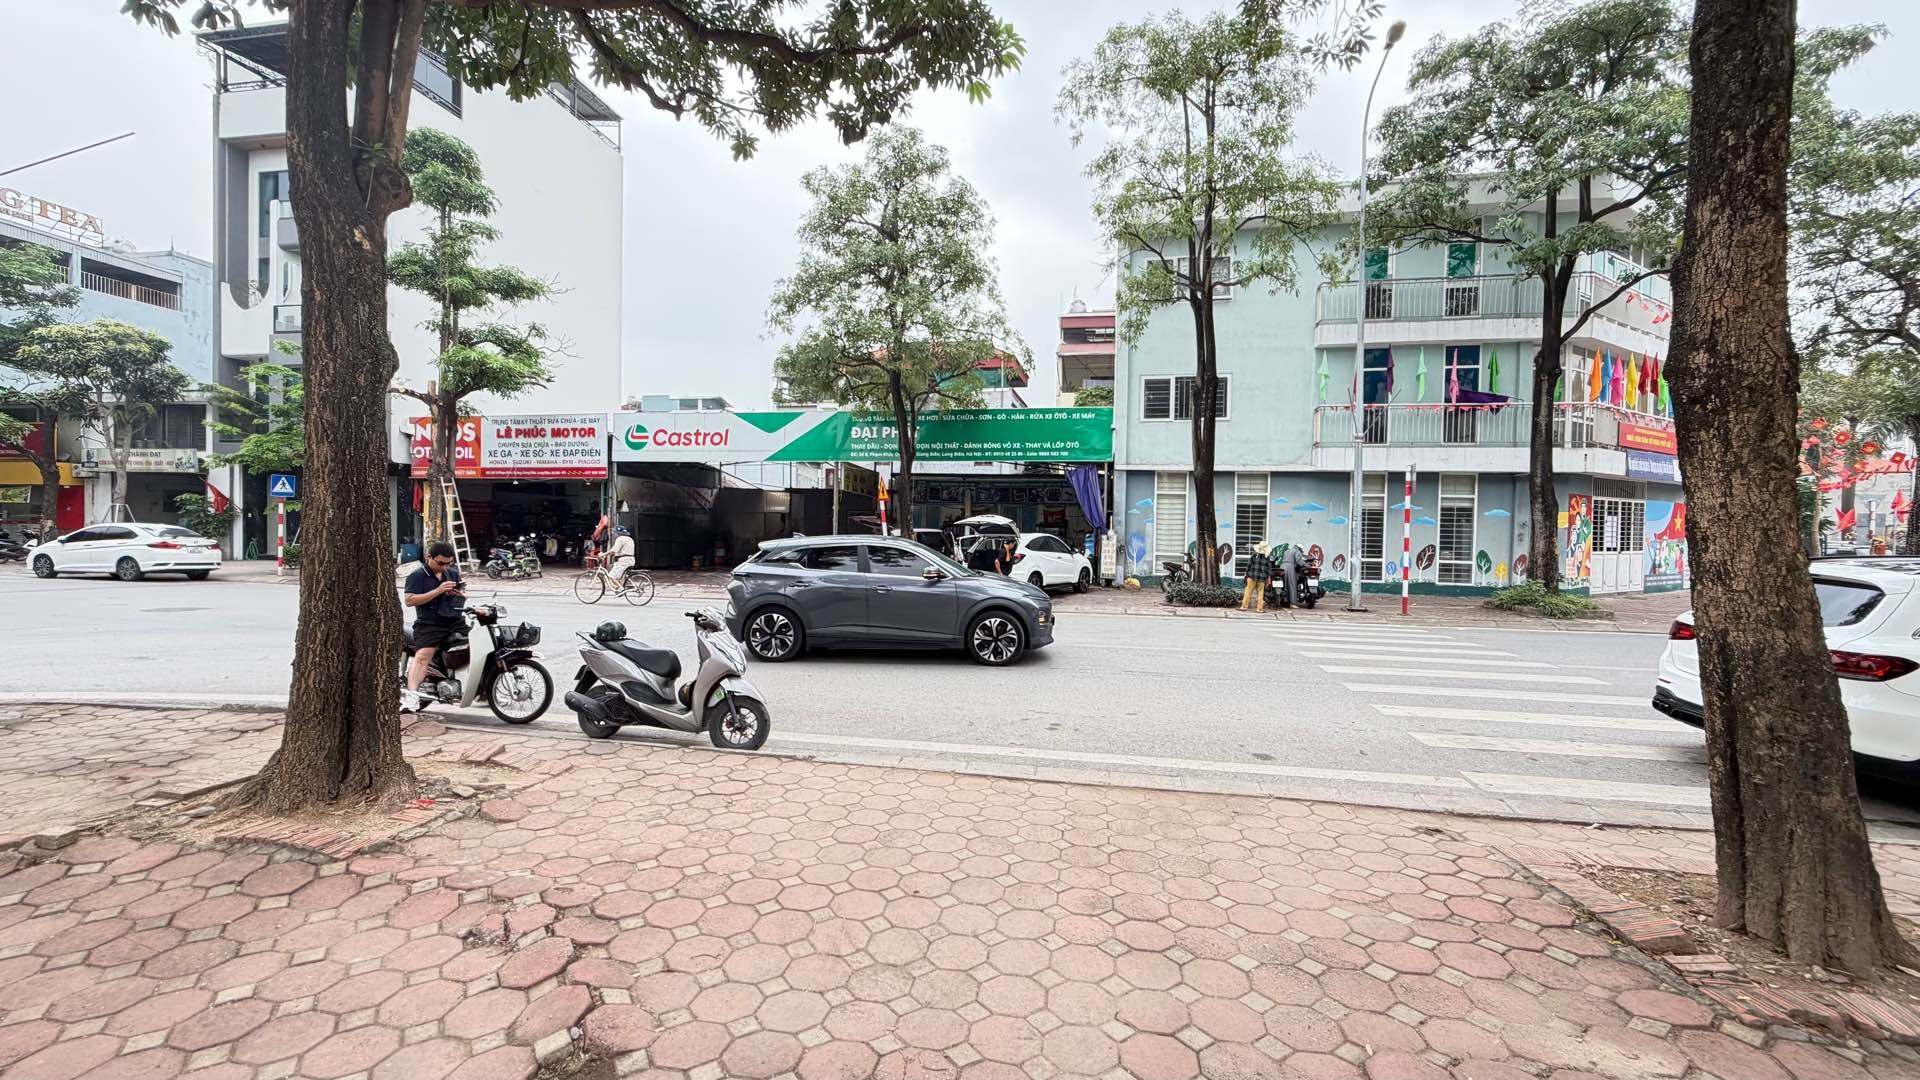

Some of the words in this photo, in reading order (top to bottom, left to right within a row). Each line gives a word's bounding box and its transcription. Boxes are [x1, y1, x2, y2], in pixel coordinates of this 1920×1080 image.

[30, 196, 104, 235] TEA
[1081, 411, 1095, 419] MÁY
[496, 425, 513, 439] LÊ
[514, 425, 547, 439] PHÚC
[550, 427, 596, 438] MOTOR
[653, 428, 730, 446] Castrol
[851, 426, 878, 441] ĐẠI
[1052, 440, 1065, 448] LỐP
[1066, 440, 1080, 448] ÔTÔ
[455, 447, 475, 459] OIL
[500, 450, 512, 458] GA
